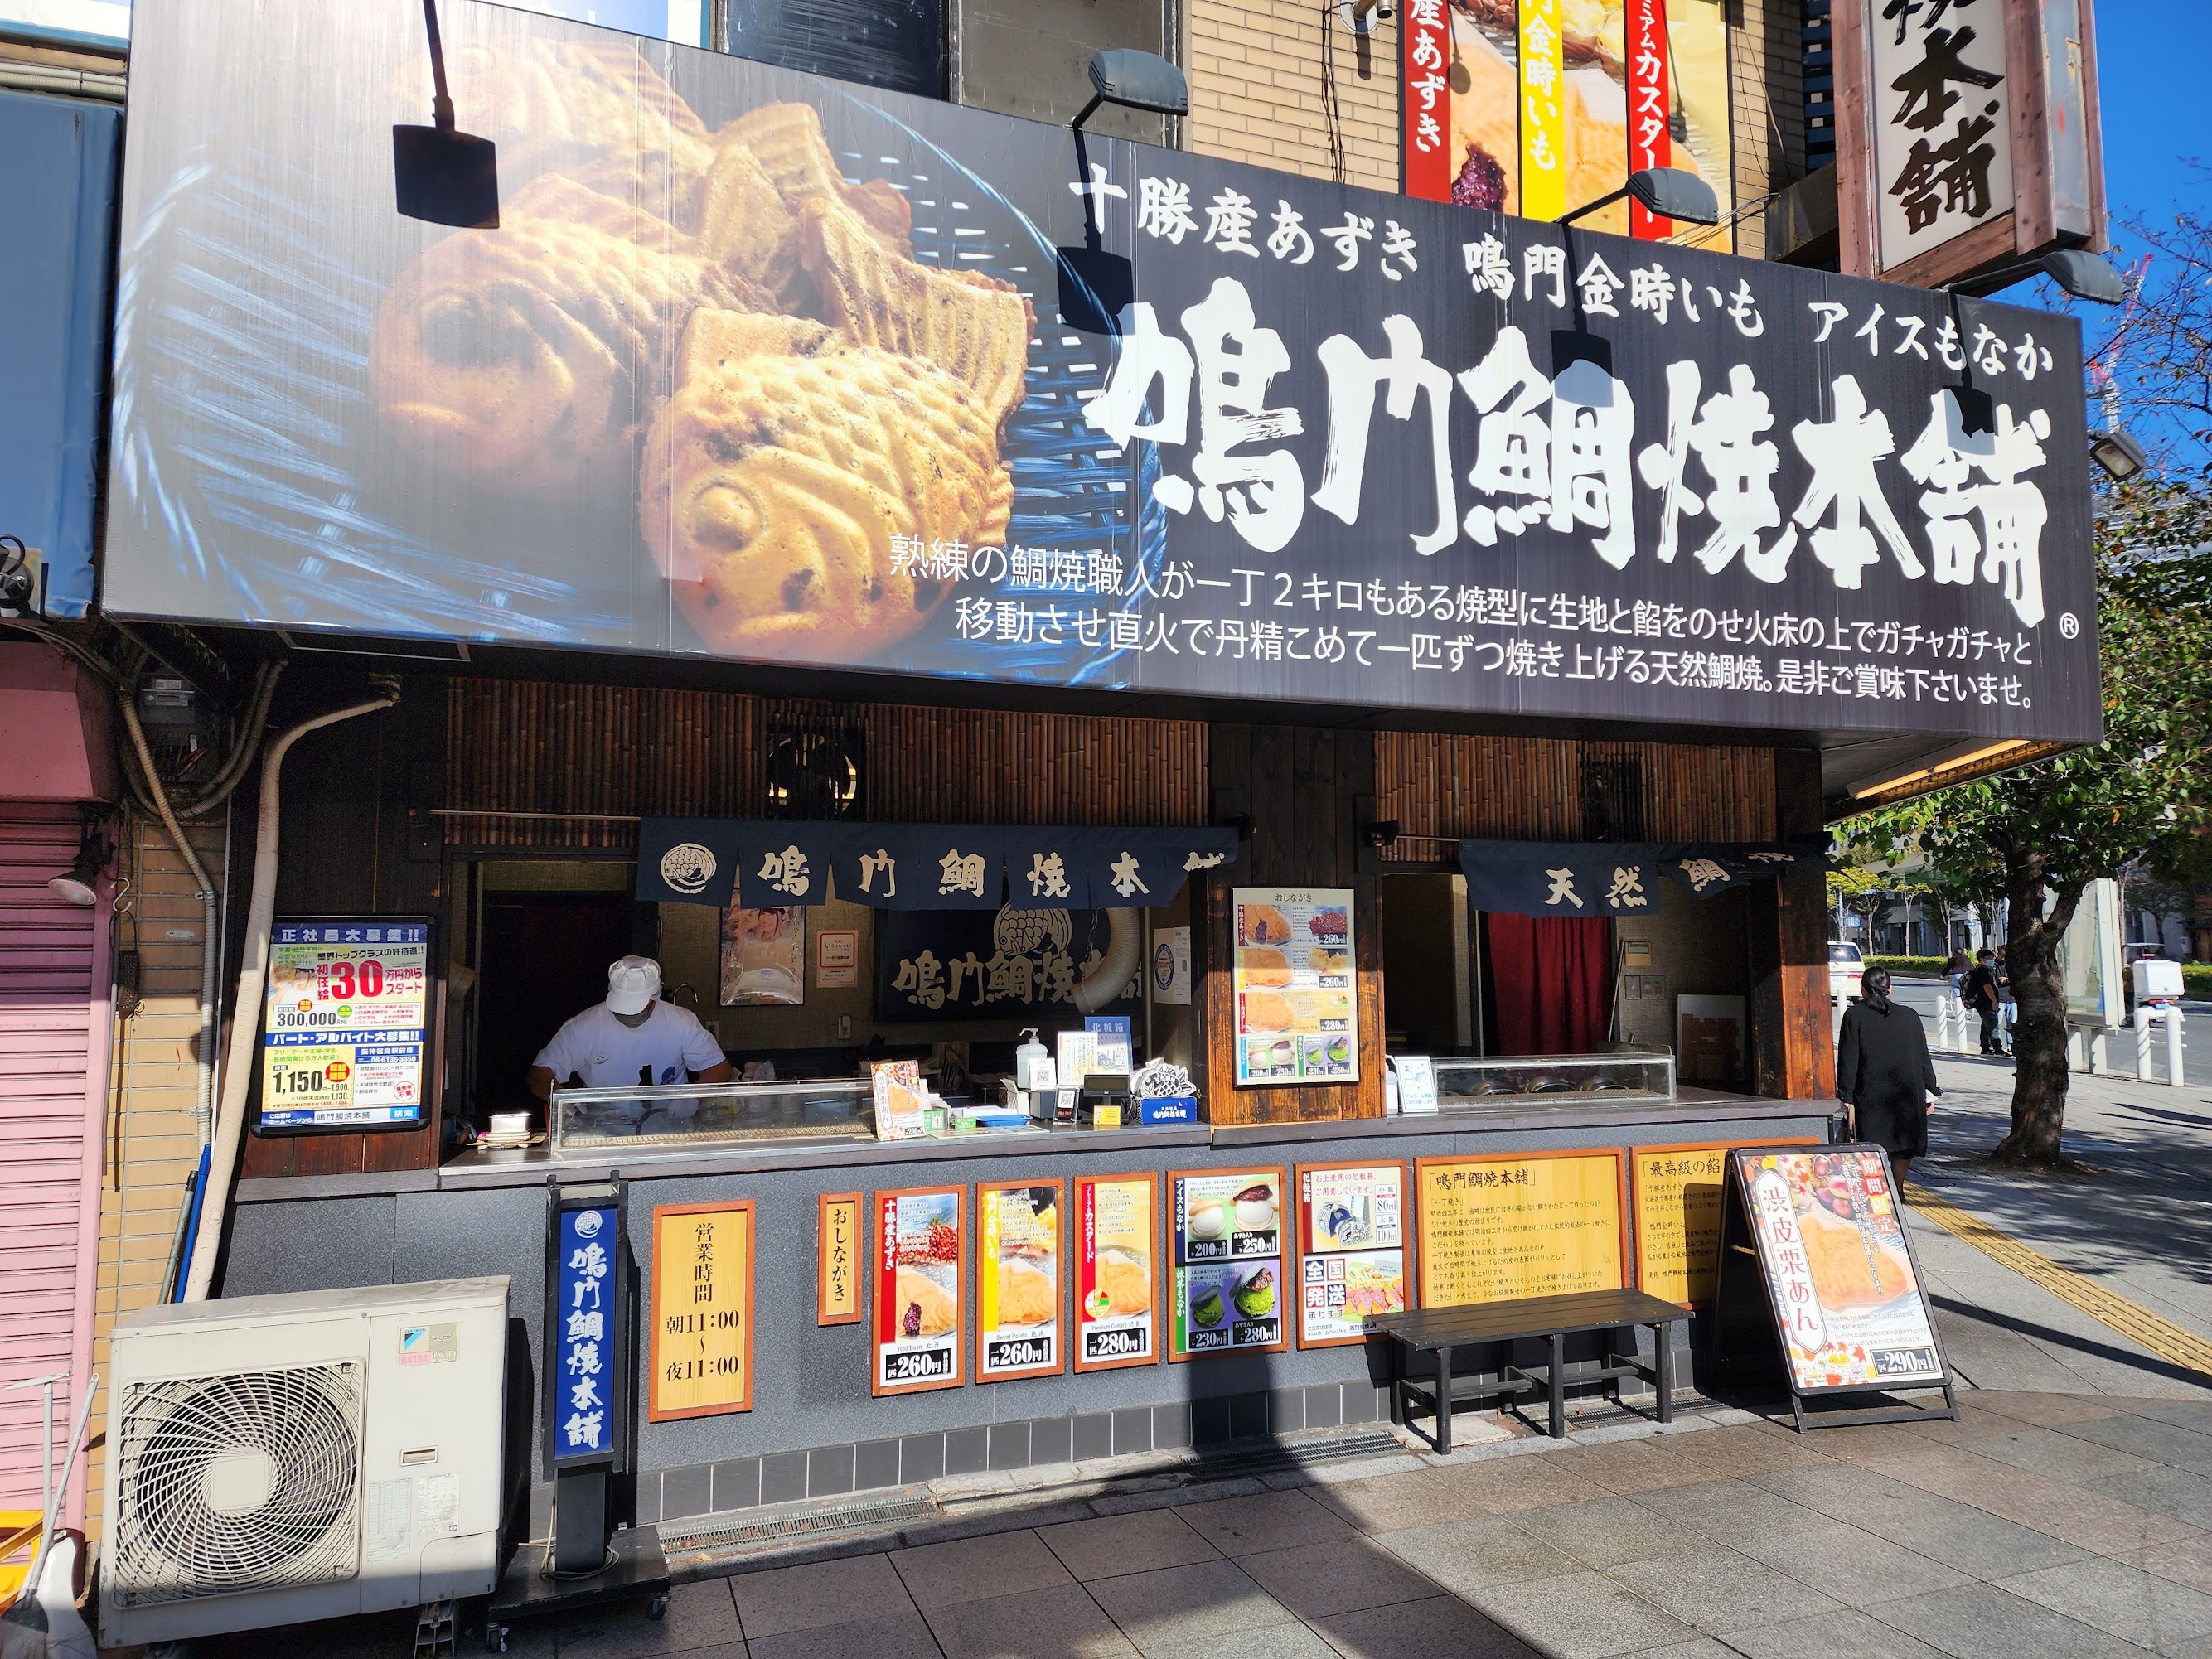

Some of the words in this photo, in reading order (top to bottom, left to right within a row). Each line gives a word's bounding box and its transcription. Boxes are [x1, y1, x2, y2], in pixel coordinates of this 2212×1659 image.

[1069, 163, 1417, 281] 十勝産あずき
[1463, 232, 1764, 337] 鳴門金時いも
[1808, 301, 2053, 381] アイスもなか
[1082, 276, 2050, 627] 鳴門鯛焼本舗
[1275, 893, 1312, 902] おしながき
[281, 928, 419, 943] 正社員大募集!!
[331, 960, 383, 999] 30
[386, 982, 423, 994] スタート
[277, 1013, 336, 1027] 300,000
[1092, 1023, 1124, 1033] 化粧箱
[273, 1031, 419, 1044] パート・アルバイト大募集!!
[273, 1071, 322, 1096] 1,150
[1315, 1185, 1372, 1196] ご用意しています。
[1429, 1168, 1536, 1190] 「鳴門鯛焼本舗」
[1175, 1180, 1184, 1232] アイスもなか
[1864, 1159, 1895, 1233] 期間限定
[884, 1199, 897, 1270] 十勝産あずき
[1085, 1185, 1094, 1263] プレミアムカスタード
[695, 1222, 714, 1304] 営業時間
[832, 1208, 849, 1302] おしながき
[1764, 1187, 1818, 1331] 渋皮栗あん
[1306, 1260, 1344, 1282] 全国
[1176, 1269, 1185, 1317] 抹茶もなか
[1306, 1284, 1346, 1307] 発送
[666, 1309, 739, 1335] 朝11:00
[1308, 1309, 1345, 1320] 承ります
[563, 1242, 607, 1449] 鳴門鯛焼本舗
[665, 1356, 738, 1382] 夜11:00
